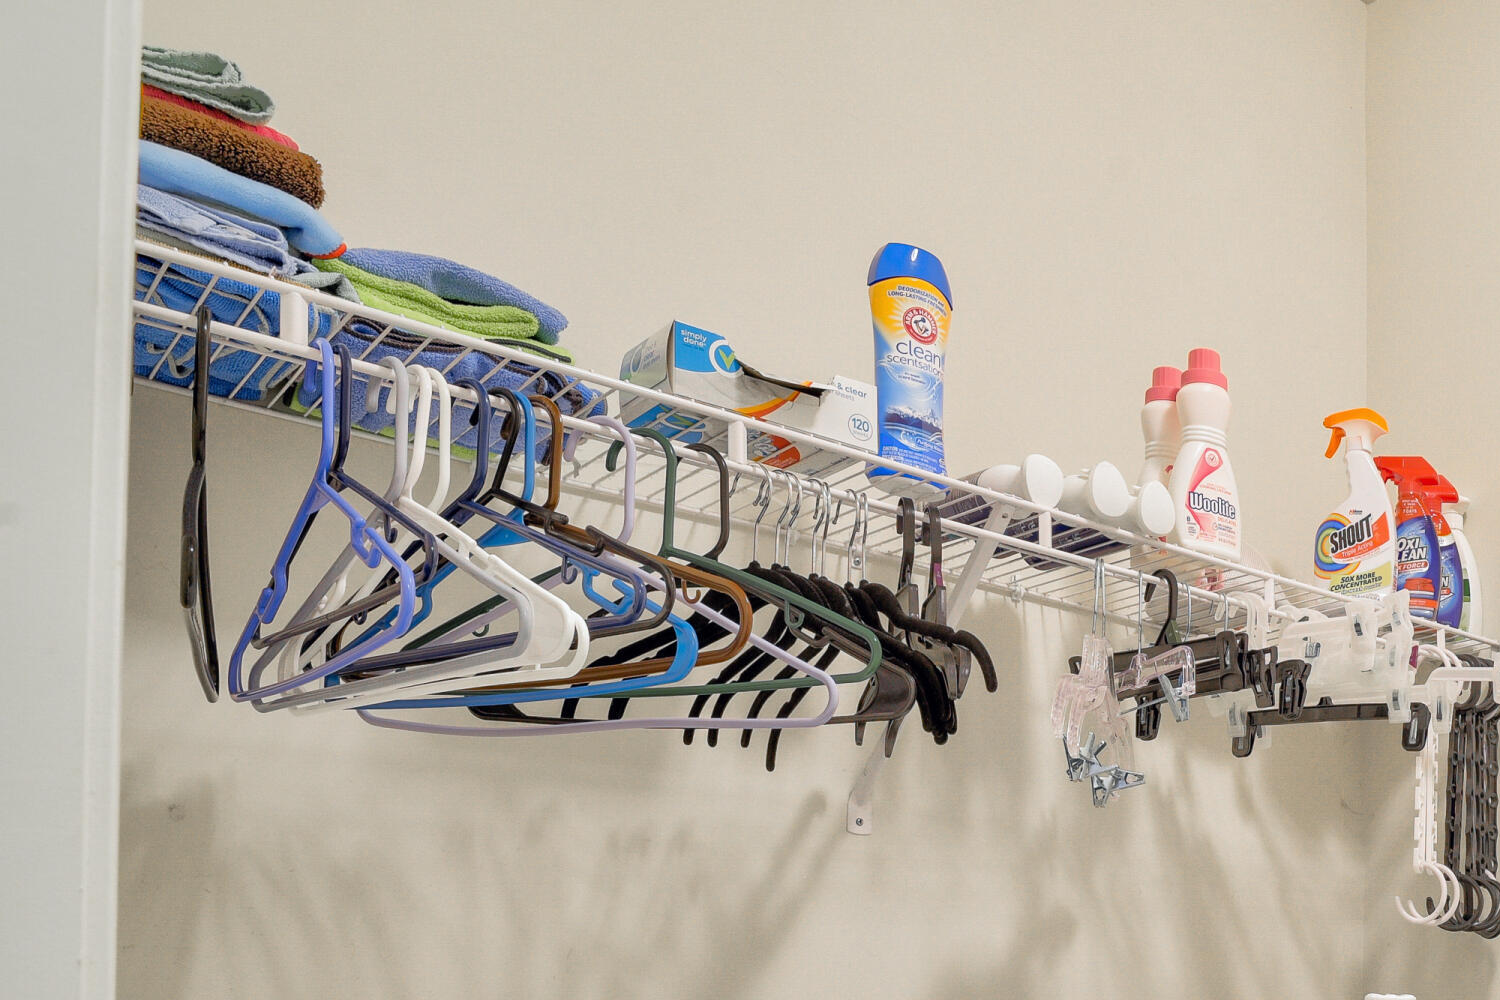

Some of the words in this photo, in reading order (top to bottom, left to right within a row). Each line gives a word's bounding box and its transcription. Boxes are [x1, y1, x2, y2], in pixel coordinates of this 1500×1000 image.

[888, 290, 927, 303] LONG-LASTING
[904, 311, 914, 325] ARM
[680, 329, 707, 342] simply
[896, 340, 941, 369] clean
[837, 382, 844, 390] &
[844, 385, 868, 399] clear
[851, 417, 870, 433] 120
[1188, 491, 1236, 519] Woolite
[1329, 512, 1372, 554] SHOUT
[1397, 537, 1421, 552] OXI
[1403, 561, 1425, 570] FORCE
[1330, 575, 1383, 592] CONCENTRATED
[1356, 571, 1376, 582] MORE
